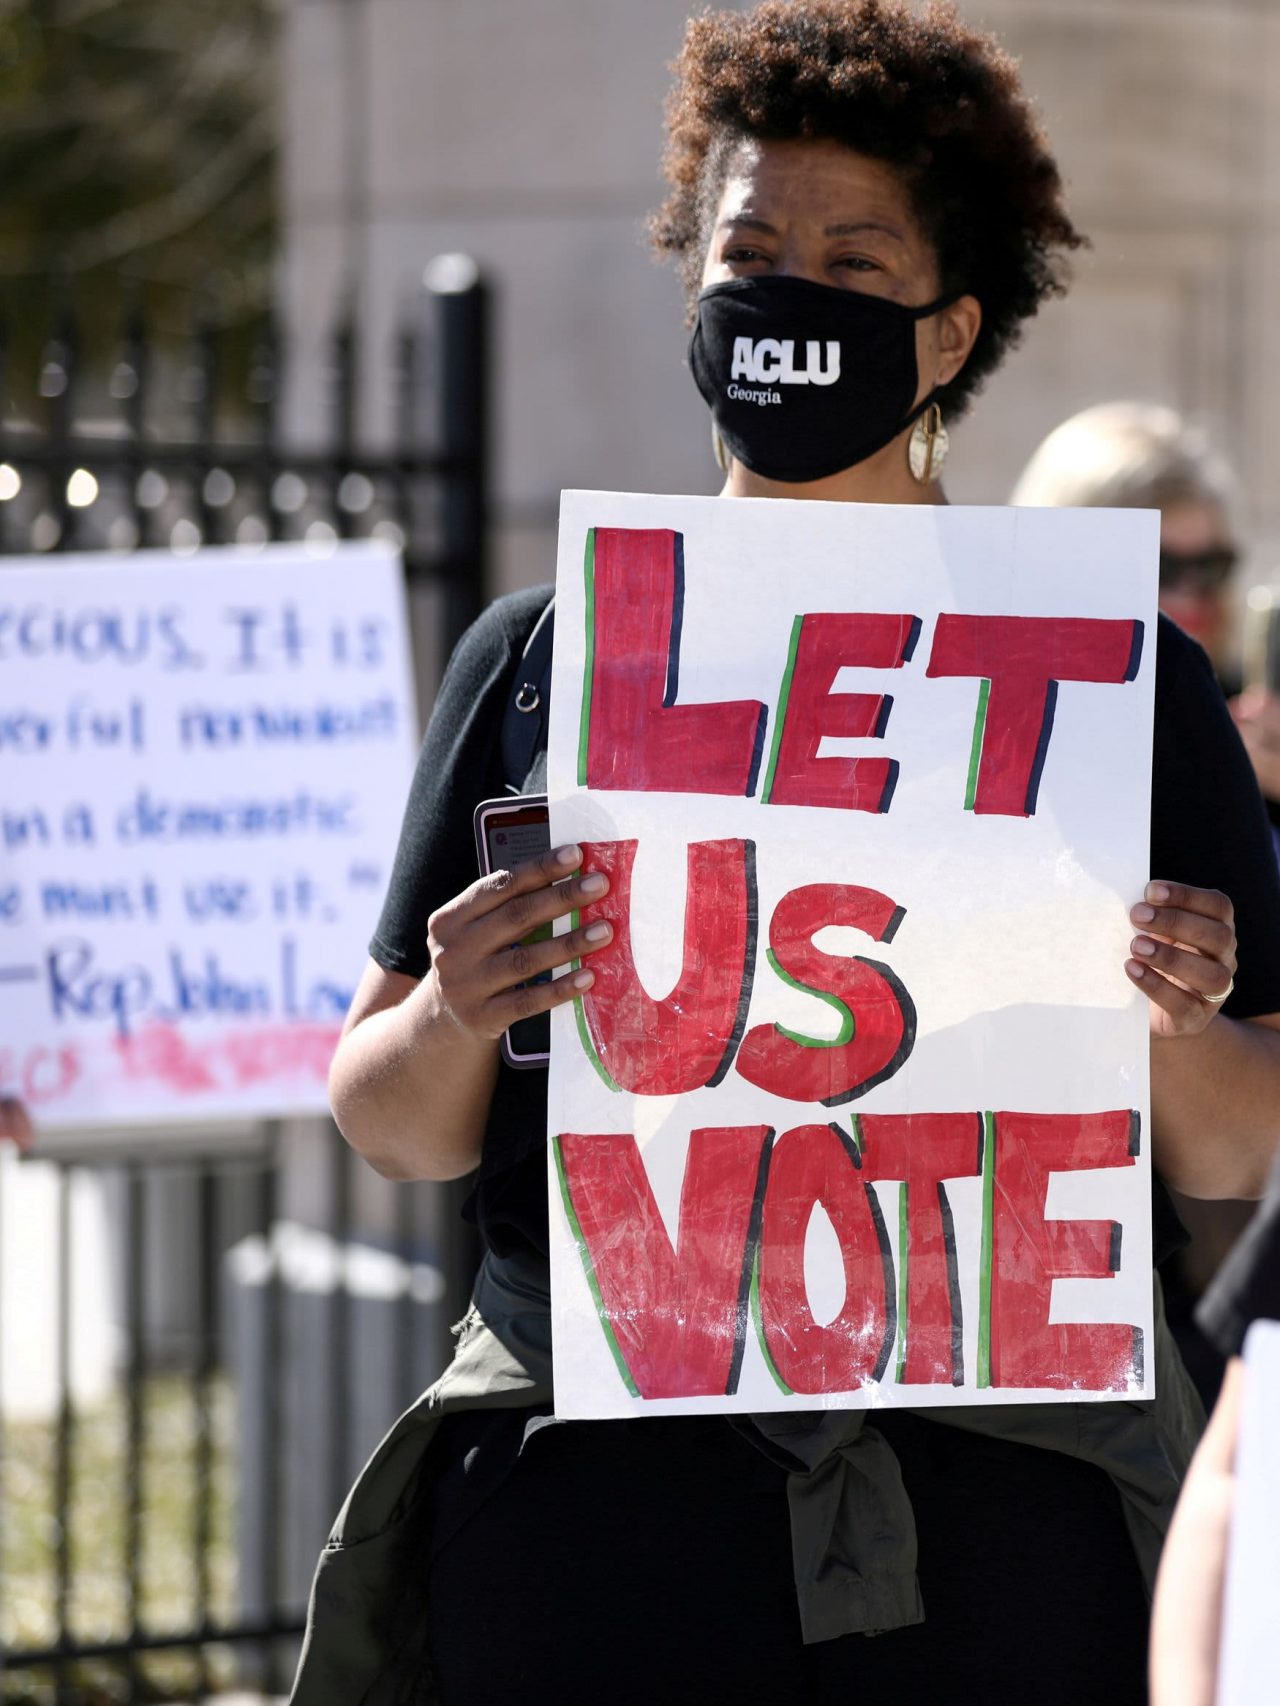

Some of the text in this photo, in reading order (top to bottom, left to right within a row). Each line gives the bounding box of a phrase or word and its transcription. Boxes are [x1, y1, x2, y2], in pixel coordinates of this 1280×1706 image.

[727, 383, 782, 406] Georgia
[731, 336, 841, 386] ACLU
[577, 527, 1145, 817] LET
[573, 838, 918, 1107] US
[553, 1110, 1145, 1399] VOTE
